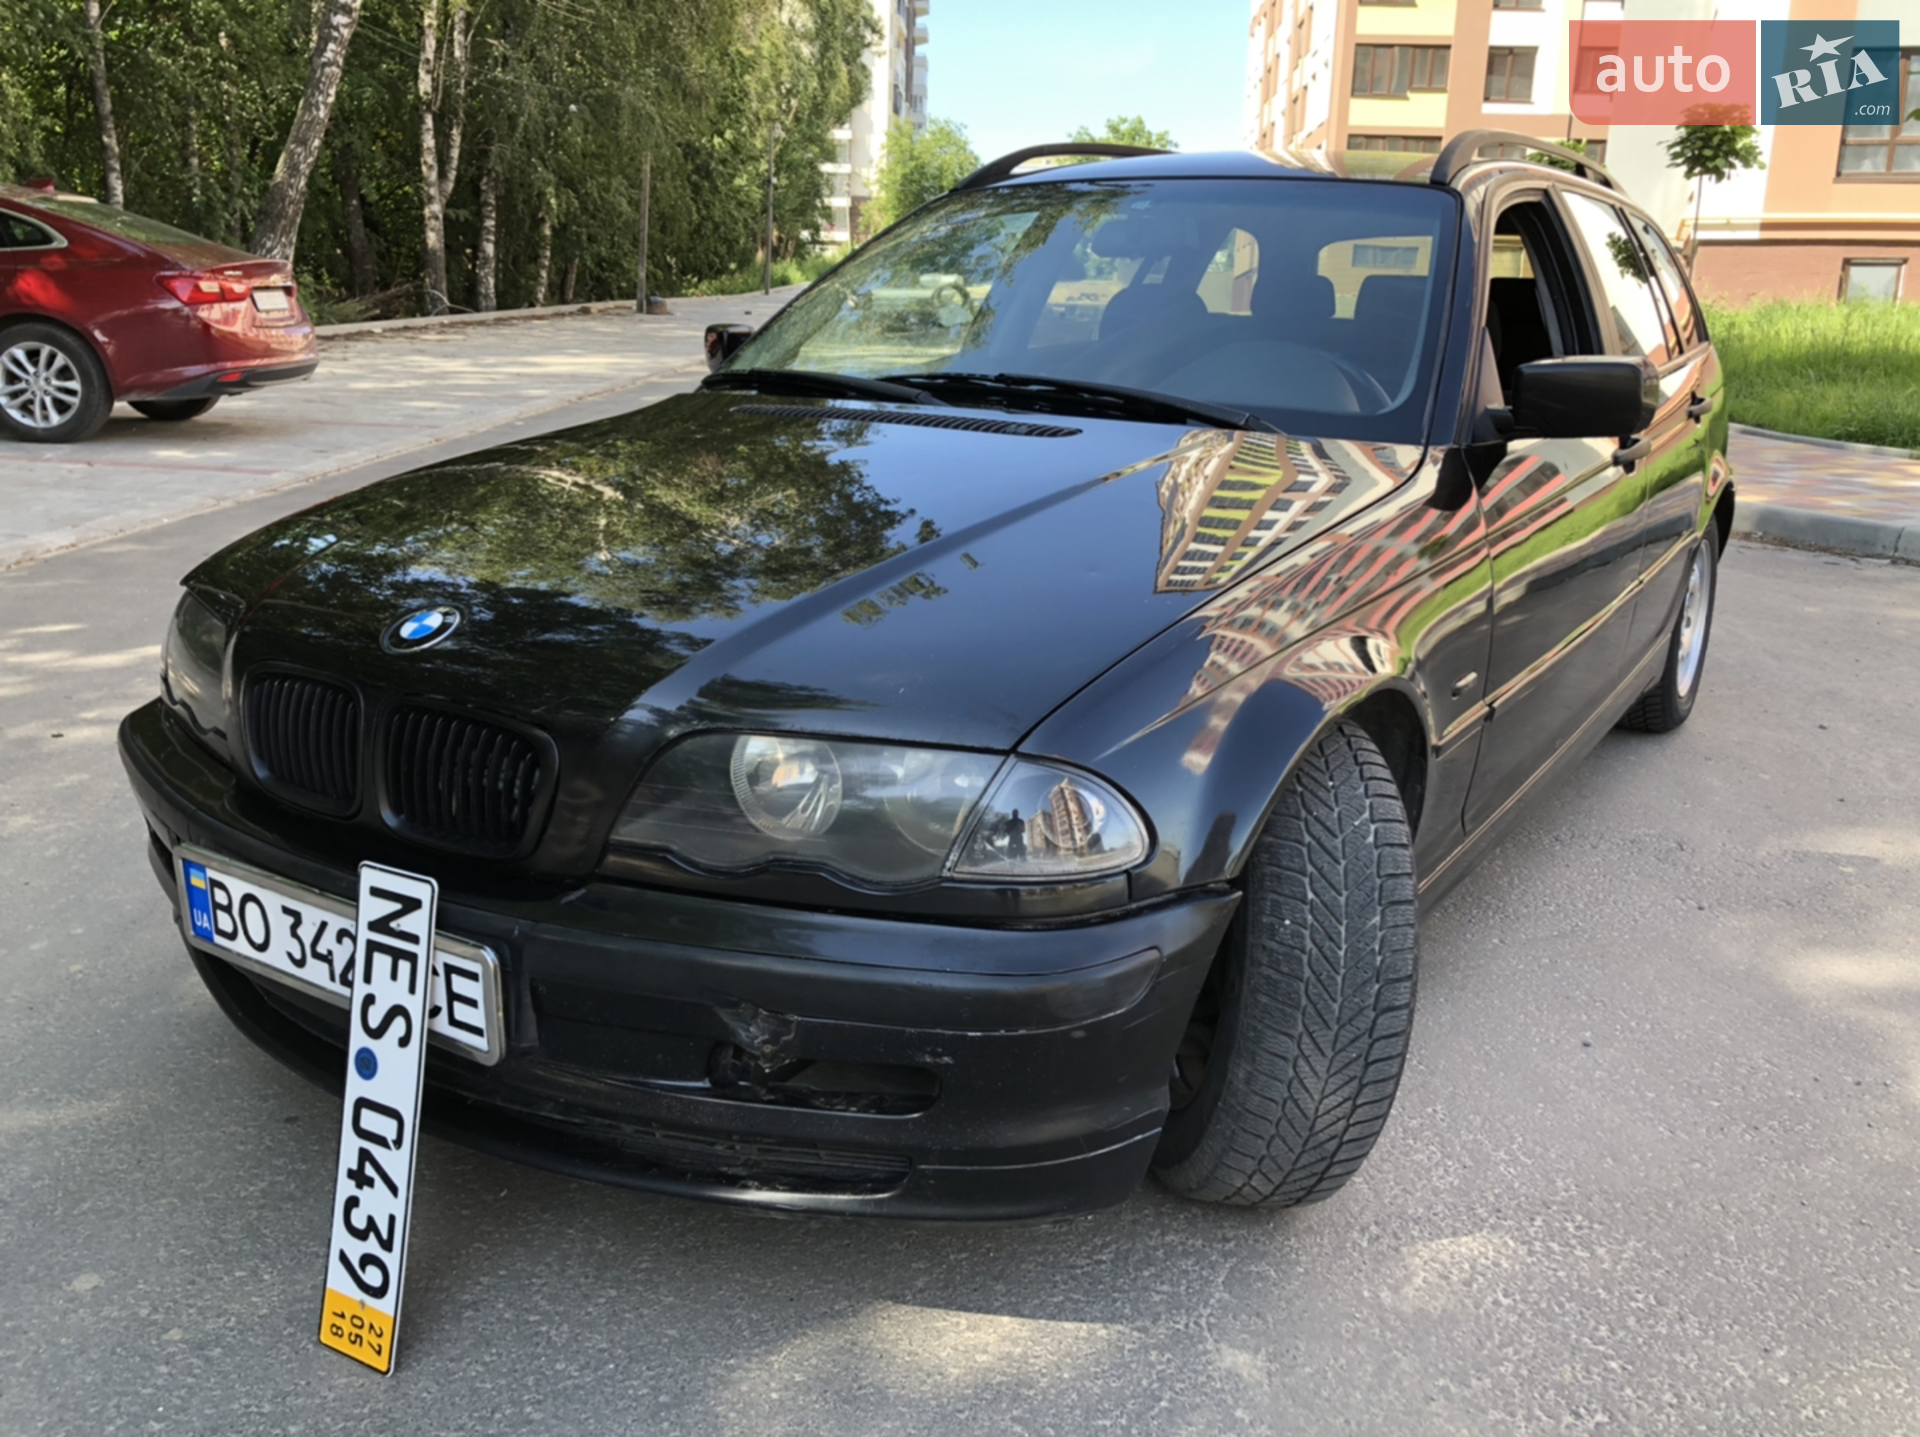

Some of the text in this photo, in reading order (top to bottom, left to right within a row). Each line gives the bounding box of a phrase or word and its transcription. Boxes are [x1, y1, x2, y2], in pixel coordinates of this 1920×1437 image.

[193, 907, 211, 931] UA
[208, 876, 271, 953] BO
[281, 904, 357, 989] 342
[338, 886, 423, 1300] NES 0439
[329, 1310, 346, 1338] 18
[348, 1314, 365, 1348] 05
[367, 1322, 384, 1357] 27
